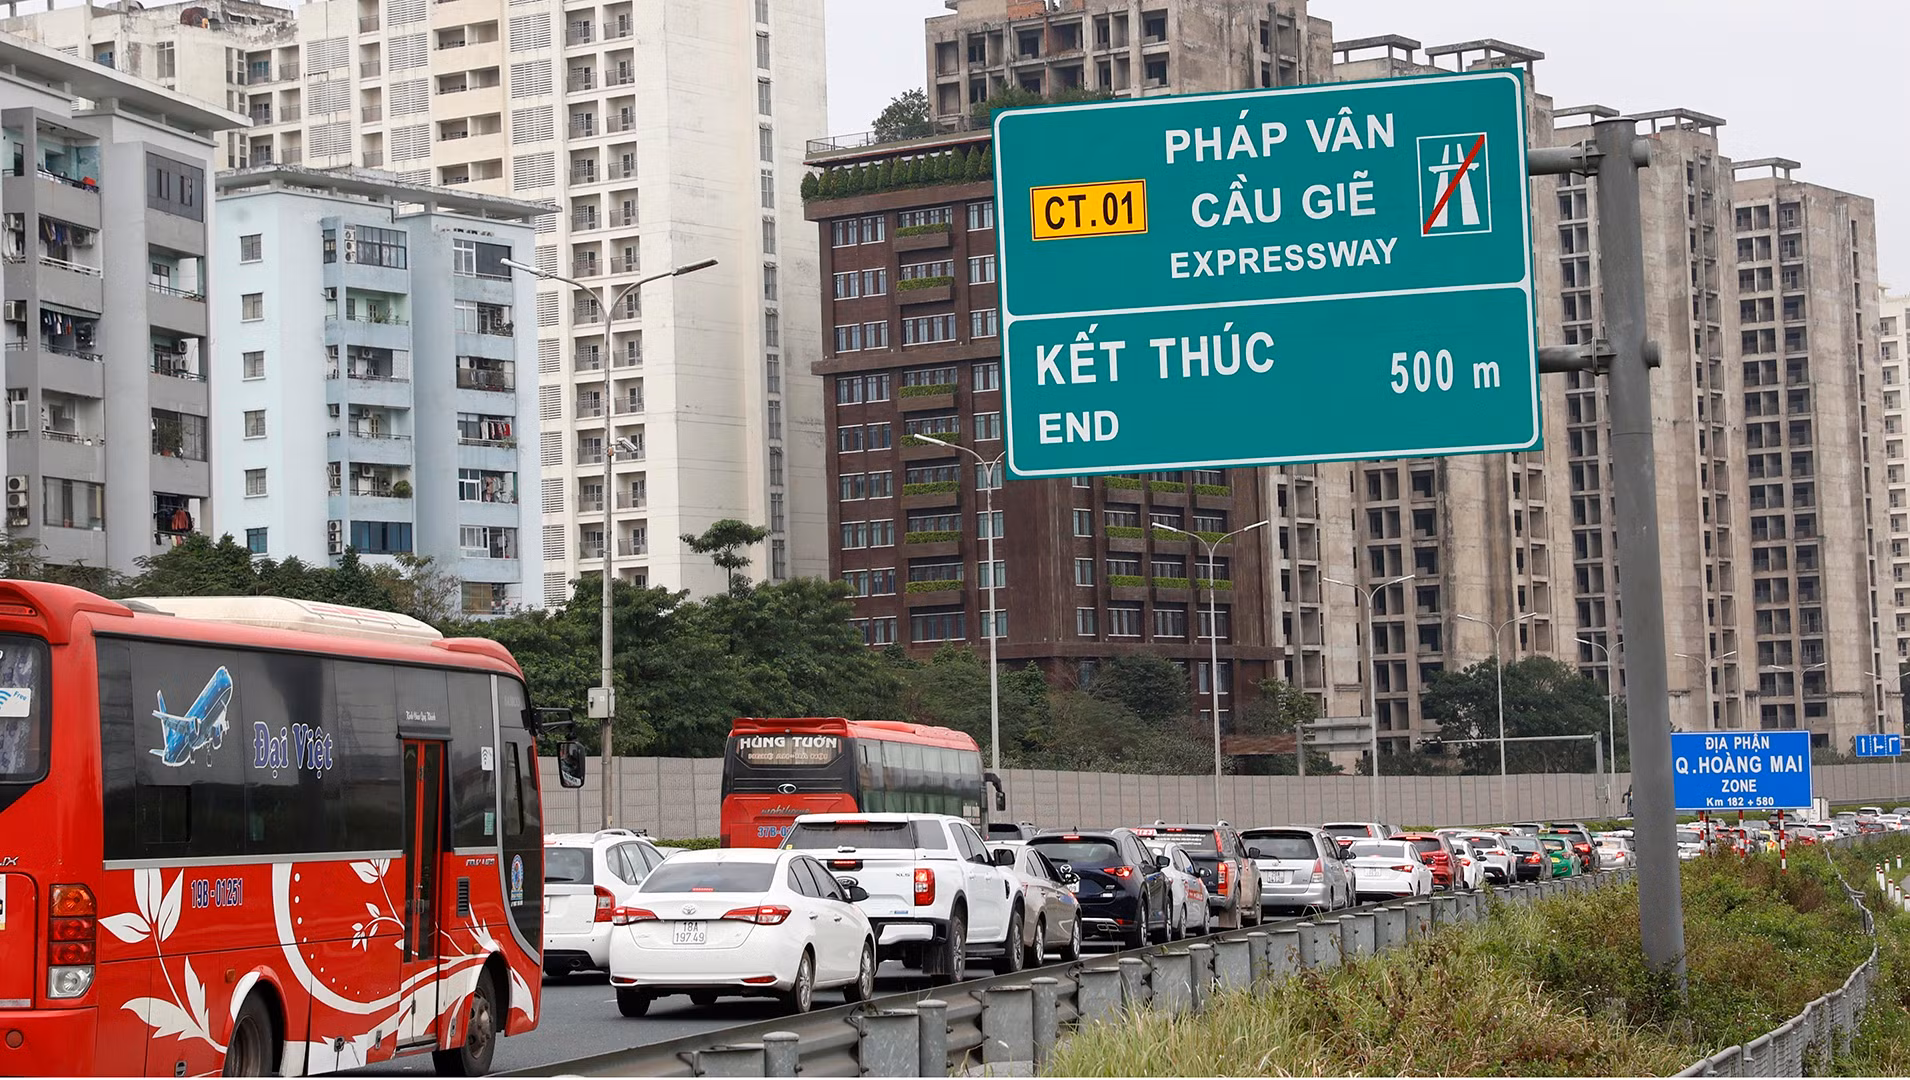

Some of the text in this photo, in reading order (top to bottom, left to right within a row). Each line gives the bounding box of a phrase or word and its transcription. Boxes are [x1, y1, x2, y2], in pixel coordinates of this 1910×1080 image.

[1165, 106, 1395, 164] PHÁP VÂN
[1045, 191, 1133, 230] CT.01
[1191, 169, 1376, 228] CẦU GIẼ
[1170, 237, 1398, 279] EXPRESSWAY
[1036, 322, 1275, 386] KẾT THÚC
[1391, 349, 1500, 394] 500 m
[1039, 410, 1119, 445] END
[253, 721, 333, 779] Đại Việt
[1705, 733, 1770, 753] ĐỊA PHẬN
[1770, 755, 1803, 773] MAI
[1706, 797, 1723, 806] Km
[1727, 797, 1744, 806] 182
[1756, 797, 1774, 806] 580
[1721, 779, 1757, 793] ZONE
[683, 921, 698, 932] 18A
